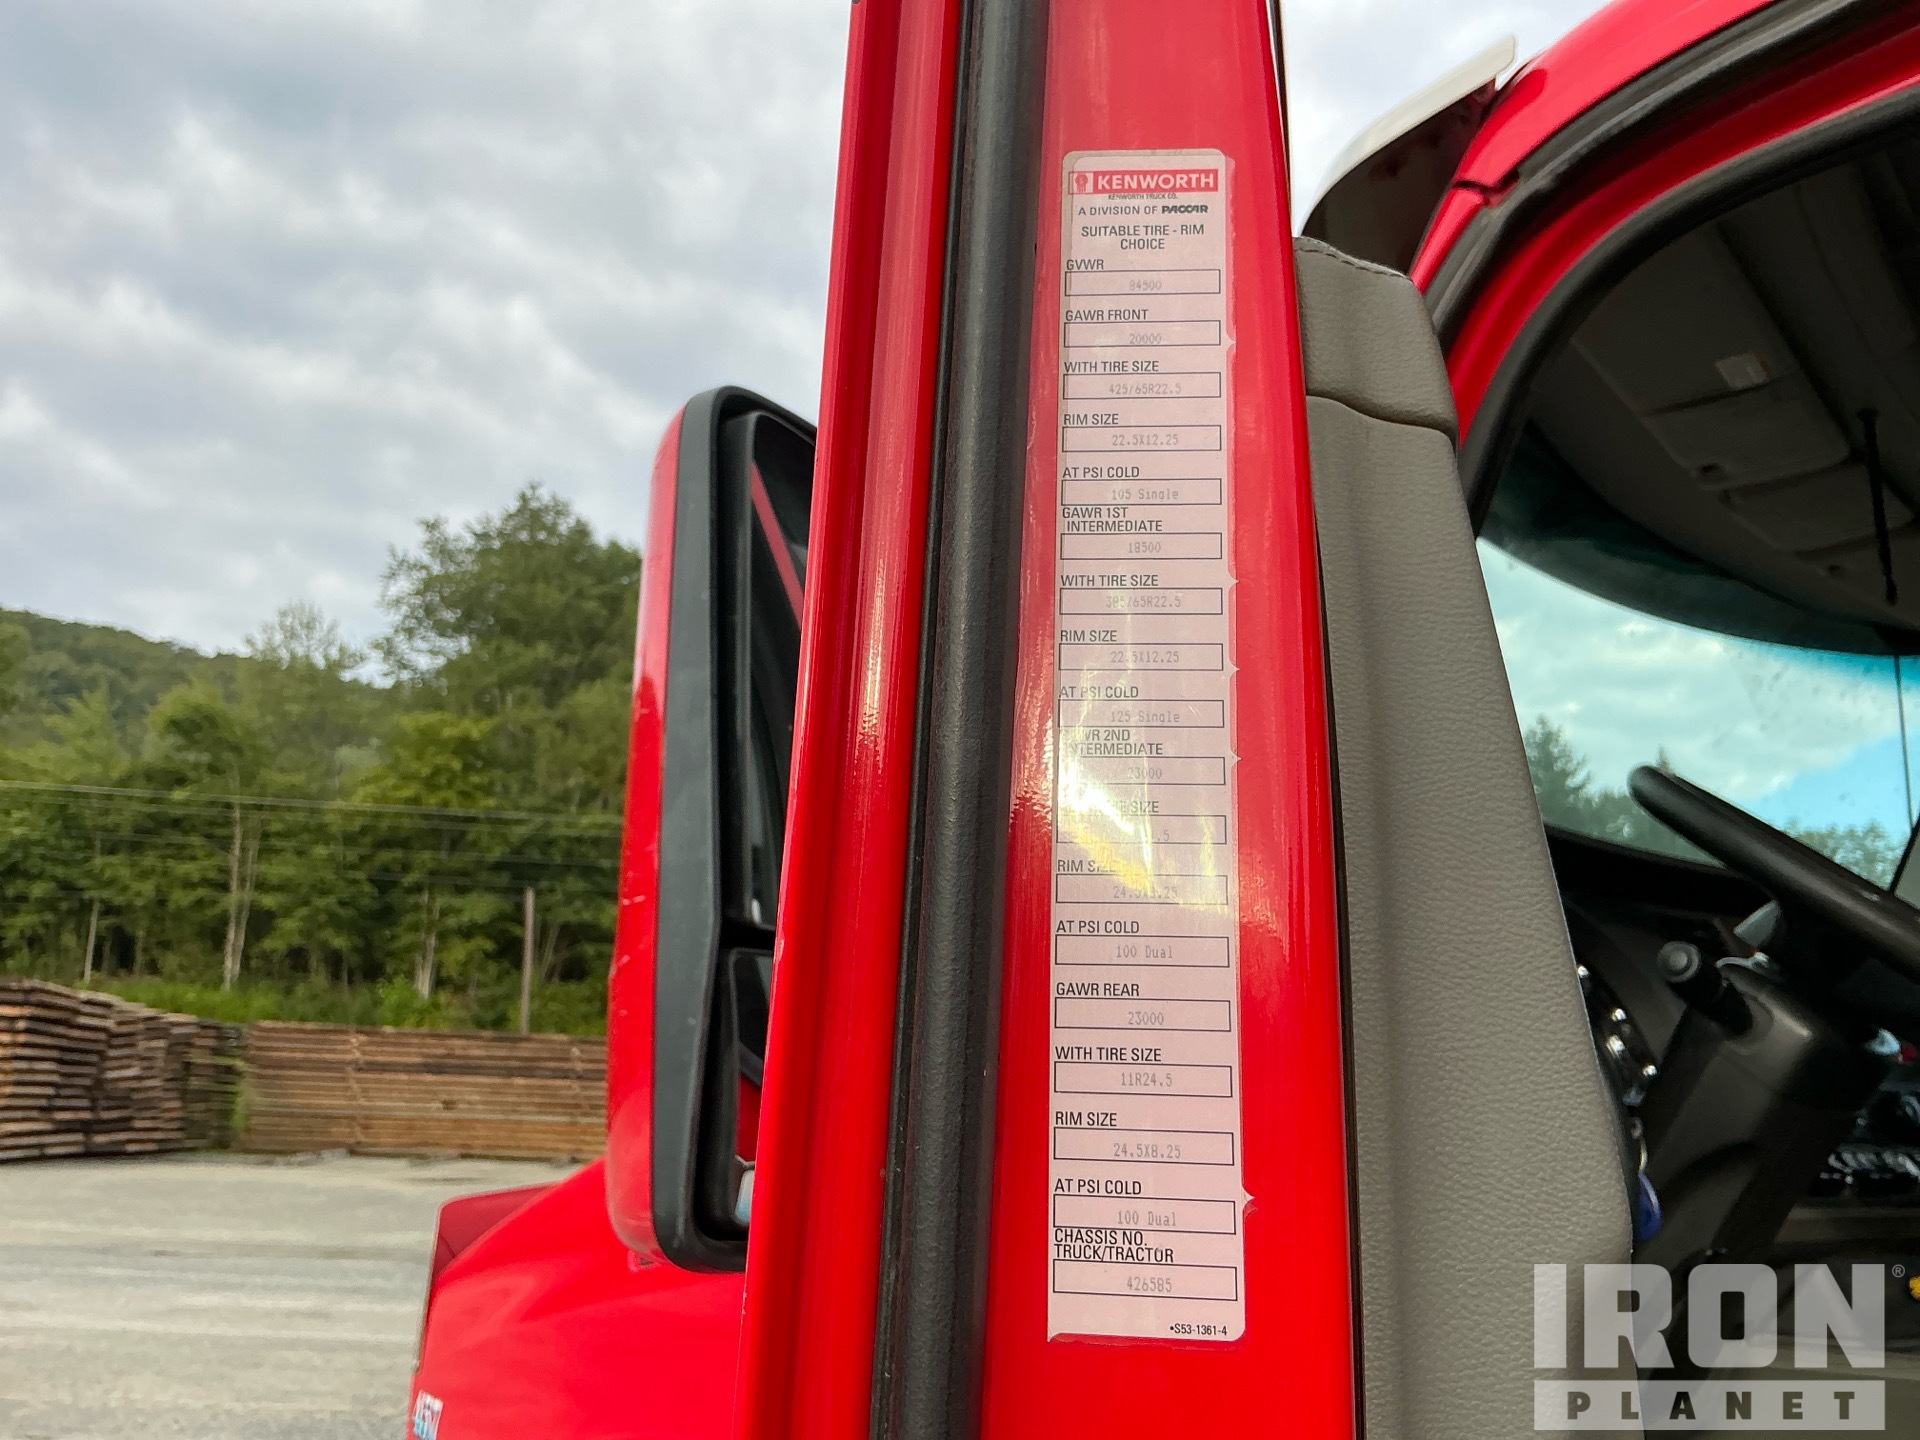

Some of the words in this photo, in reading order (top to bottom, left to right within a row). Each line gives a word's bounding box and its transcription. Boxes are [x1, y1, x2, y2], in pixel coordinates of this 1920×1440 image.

[1098, 173, 1214, 190] KENWORTH
[1078, 207, 1086, 215] A
[1090, 206, 1140, 215] DIVISION
[1144, 206, 1158, 214] OF
[1162, 205, 1208, 214] PACCAR
[1081, 225, 1140, 237] SUITABLE
[1143, 225, 1169, 236] TIRE
[1180, 224, 1204, 235] RIM
[1120, 238, 1165, 250] CHOICE
[1066, 259, 1104, 270] GVWR
[1065, 310, 1104, 321] GAWR
[1108, 309, 1149, 320] FRONT
[1129, 333, 1162, 344] 20000
[1064, 362, 1098, 373] WITH
[1101, 361, 1128, 372] TIRE
[1132, 361, 1159, 372] SIZE
[1108, 384, 1182, 395] 425/65R22.5
[1064, 414, 1088, 425] RIM
[1092, 414, 1119, 425] SIZE
[1112, 434, 1179, 446] 22.5X12.25
[1062, 467, 1079, 478] AT
[1083, 467, 1103, 478] PSI
[1107, 466, 1140, 478] COLD
[1112, 489, 1132, 500] 105
[1138, 488, 1179, 500] Single
[1062, 507, 1102, 518] GAWR
[1106, 507, 1128, 518] 1ST
[1067, 520, 1162, 532] INTERMEDIATE
[1128, 542, 1161, 554] 18500
[1060, 575, 1095, 587] WITH
[1098, 575, 1127, 586] TIRE
[1130, 575, 1159, 586] SIZE
[1060, 630, 1085, 642] RIM
[1089, 630, 1117, 642] SIZE
[1059, 687, 1076, 698] AT
[1080, 687, 1100, 698] PSI
[1105, 686, 1139, 698] COLD
[1111, 711, 1131, 723] 125
[1138, 711, 1180, 723] Single
[1062, 730, 1100, 741] WR
[1104, 730, 1130, 741] 2ND
[1057, 860, 1083, 872] RIM
[1056, 921, 1074, 933] AT
[1079, 921, 1100, 933] PSI
[1104, 921, 1139, 933] COLD
[1116, 945, 1137, 958] 100
[1145, 946, 1173, 958] Dual
[1056, 983, 1099, 996] GAWR
[1103, 983, 1140, 996] REAR
[1128, 1012, 1164, 1025] 23000
[1055, 1047, 1092, 1060] WITH
[1096, 1047, 1127, 1061] TIRE
[1131, 1048, 1161, 1061] SIZE
[1121, 1073, 1173, 1087] 11R24.5
[1055, 1111, 1082, 1125] RIM
[1087, 1112, 1117, 1126] SIZE
[1113, 1143, 1181, 1159] 24.5X8.25
[1055, 1179, 1073, 1192] AT
[1078, 1179, 1100, 1193] PSI
[1105, 1180, 1142, 1195] COLD
[1118, 1210, 1139, 1225] 100
[1148, 1212, 1176, 1226] Dual
[1055, 1228, 1117, 1244] CHASSIS
[1122, 1231, 1147, 1246] NO.
[1054, 1244, 1174, 1262] TRUCK/TRACTOR
[1127, 1276, 1172, 1292] 426585
